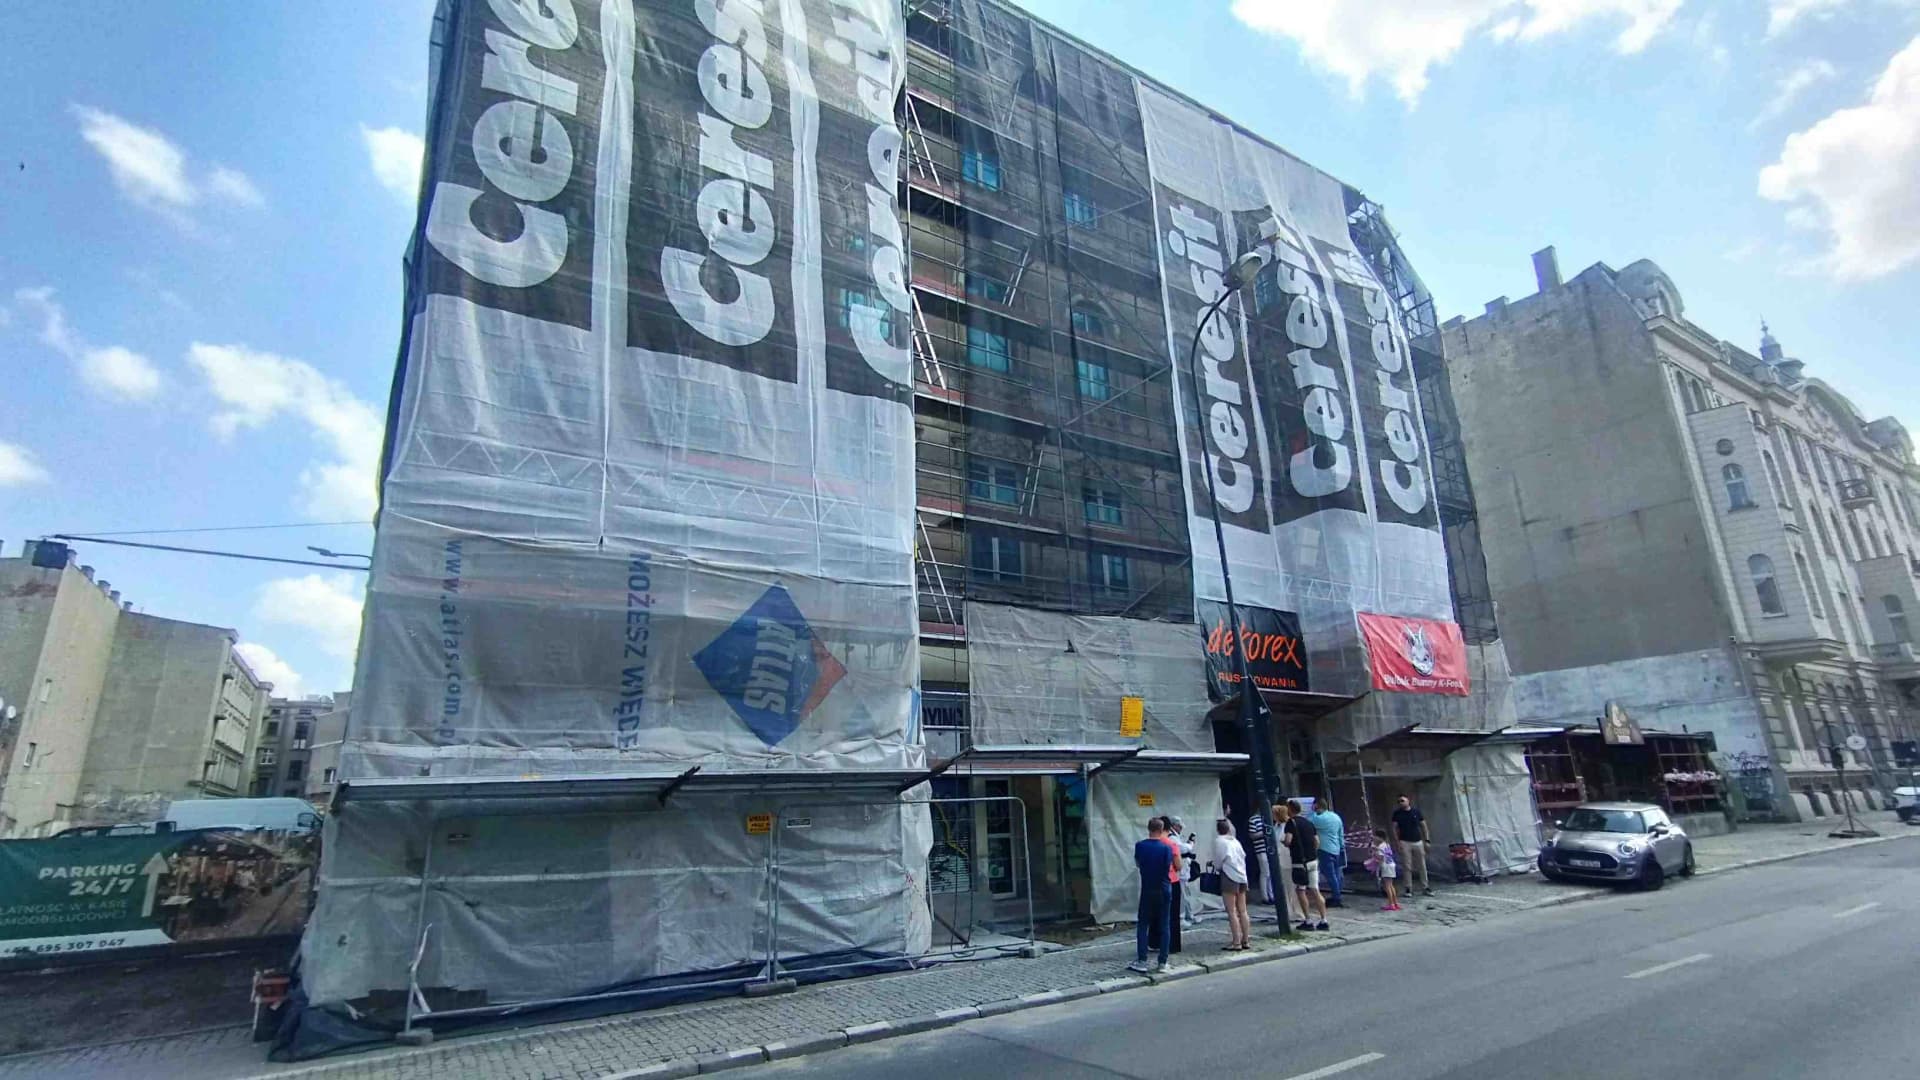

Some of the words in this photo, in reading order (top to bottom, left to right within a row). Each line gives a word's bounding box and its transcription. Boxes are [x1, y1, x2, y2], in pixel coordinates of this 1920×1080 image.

[1168, 203, 1254, 513] Ceresit
[624, 553, 656, 660] MOŻESZ
[1207, 617, 1303, 669] dekorex
[744, 616, 796, 715] ATLAS
[1412, 677, 1437, 688] Bunny
[39, 863, 136, 879] PARKING
[69, 877, 134, 895] 24/7
[37, 942, 61, 952] 695
[67, 941, 93, 950] 307
